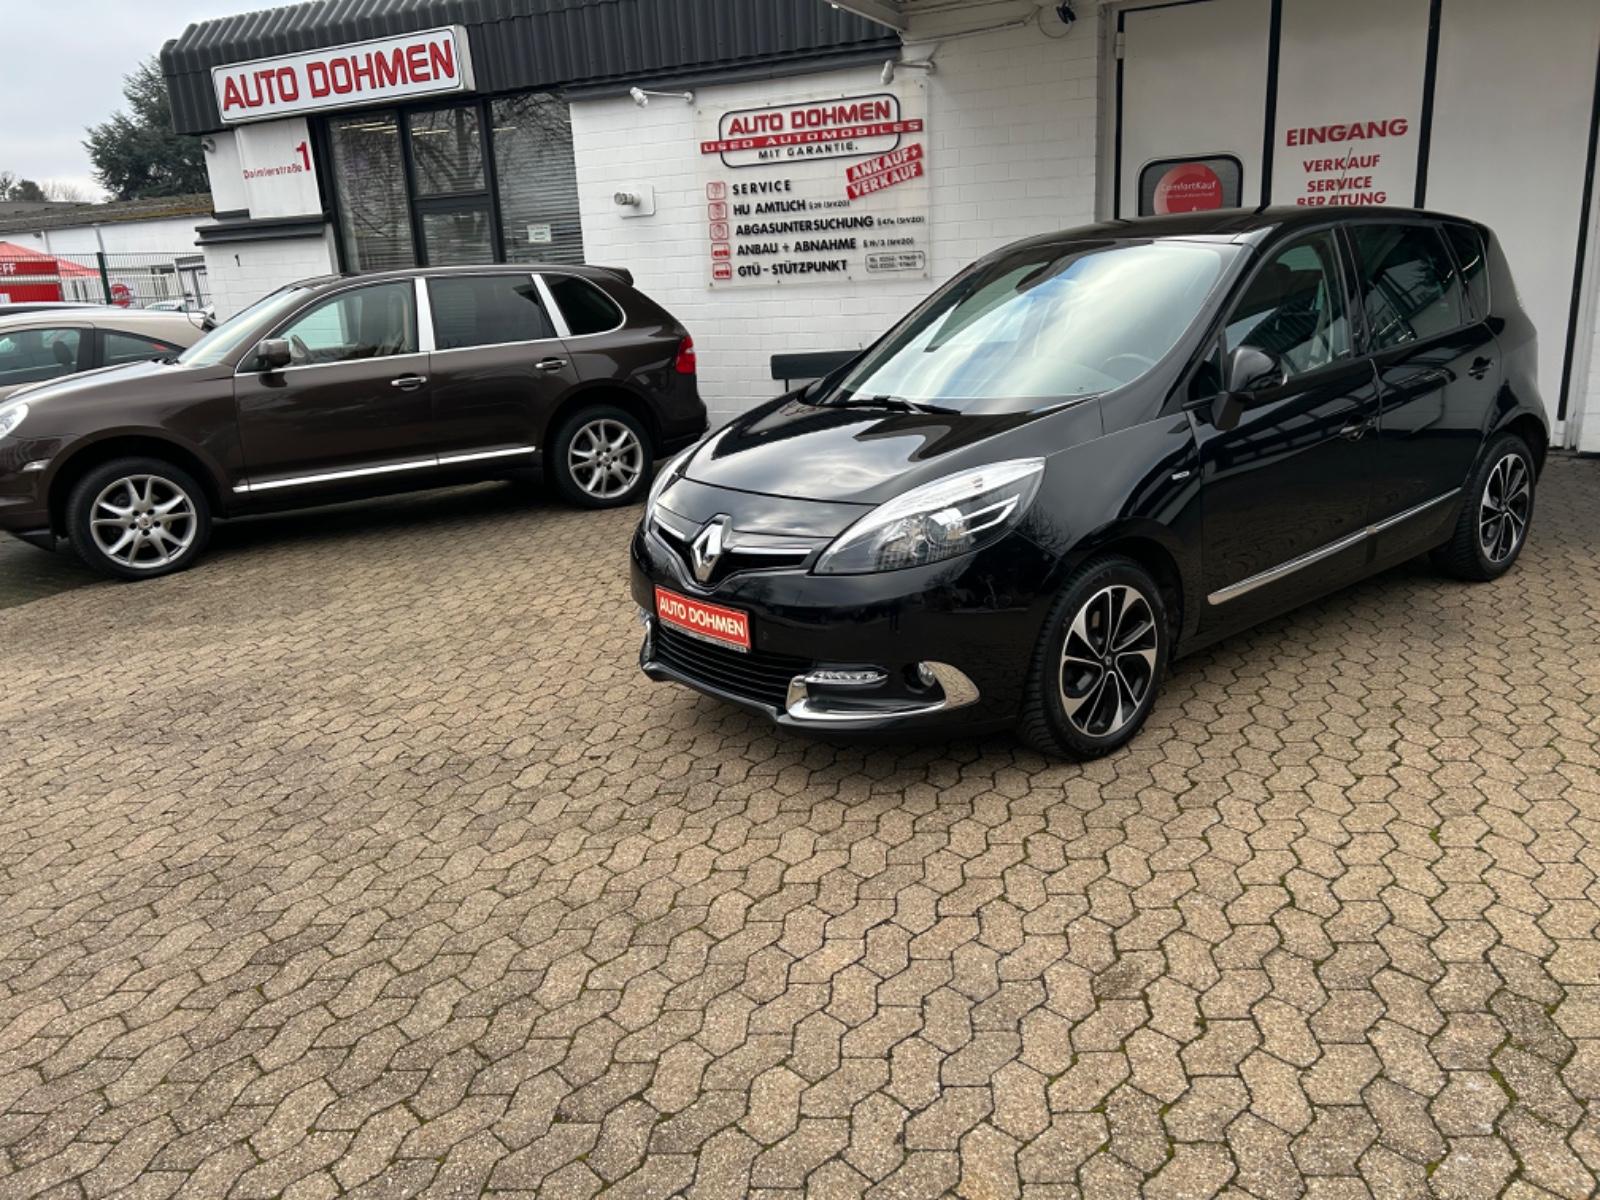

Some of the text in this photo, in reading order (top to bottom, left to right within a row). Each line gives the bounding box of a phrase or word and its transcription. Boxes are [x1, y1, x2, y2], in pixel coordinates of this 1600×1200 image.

[223, 39, 456, 112] AUTO DOHMEN
[728, 100, 891, 135] AUTO DOHMEN
[703, 121, 921, 152] USED AUTOMOBILES
[1286, 118, 1409, 147] EINGANG
[296, 141, 311, 171] 1
[758, 142, 859, 160] MIT GARANTIE.
[243, 163, 303, 180] Daimlerstraße
[1303, 155, 1381, 173] VERKAUF
[732, 179, 791, 195] SERVICE
[851, 164, 918, 196] VERKAUF
[1307, 176, 1373, 193] SERVICE
[733, 204, 750, 215] HU
[755, 200, 806, 214] AMTLICH
[1296, 191, 1387, 207] BERATUNG
[736, 216, 874, 236] ABGASUNTERSUCHUNG
[737, 242, 778, 256] ANBAU
[794, 238, 857, 253] ABNAHME
[738, 261, 760, 277] GTÜ
[772, 259, 848, 276] STÜTZPUNKT
[660, 597, 687, 619] AUTO
[689, 607, 745, 637] DOHMEN
